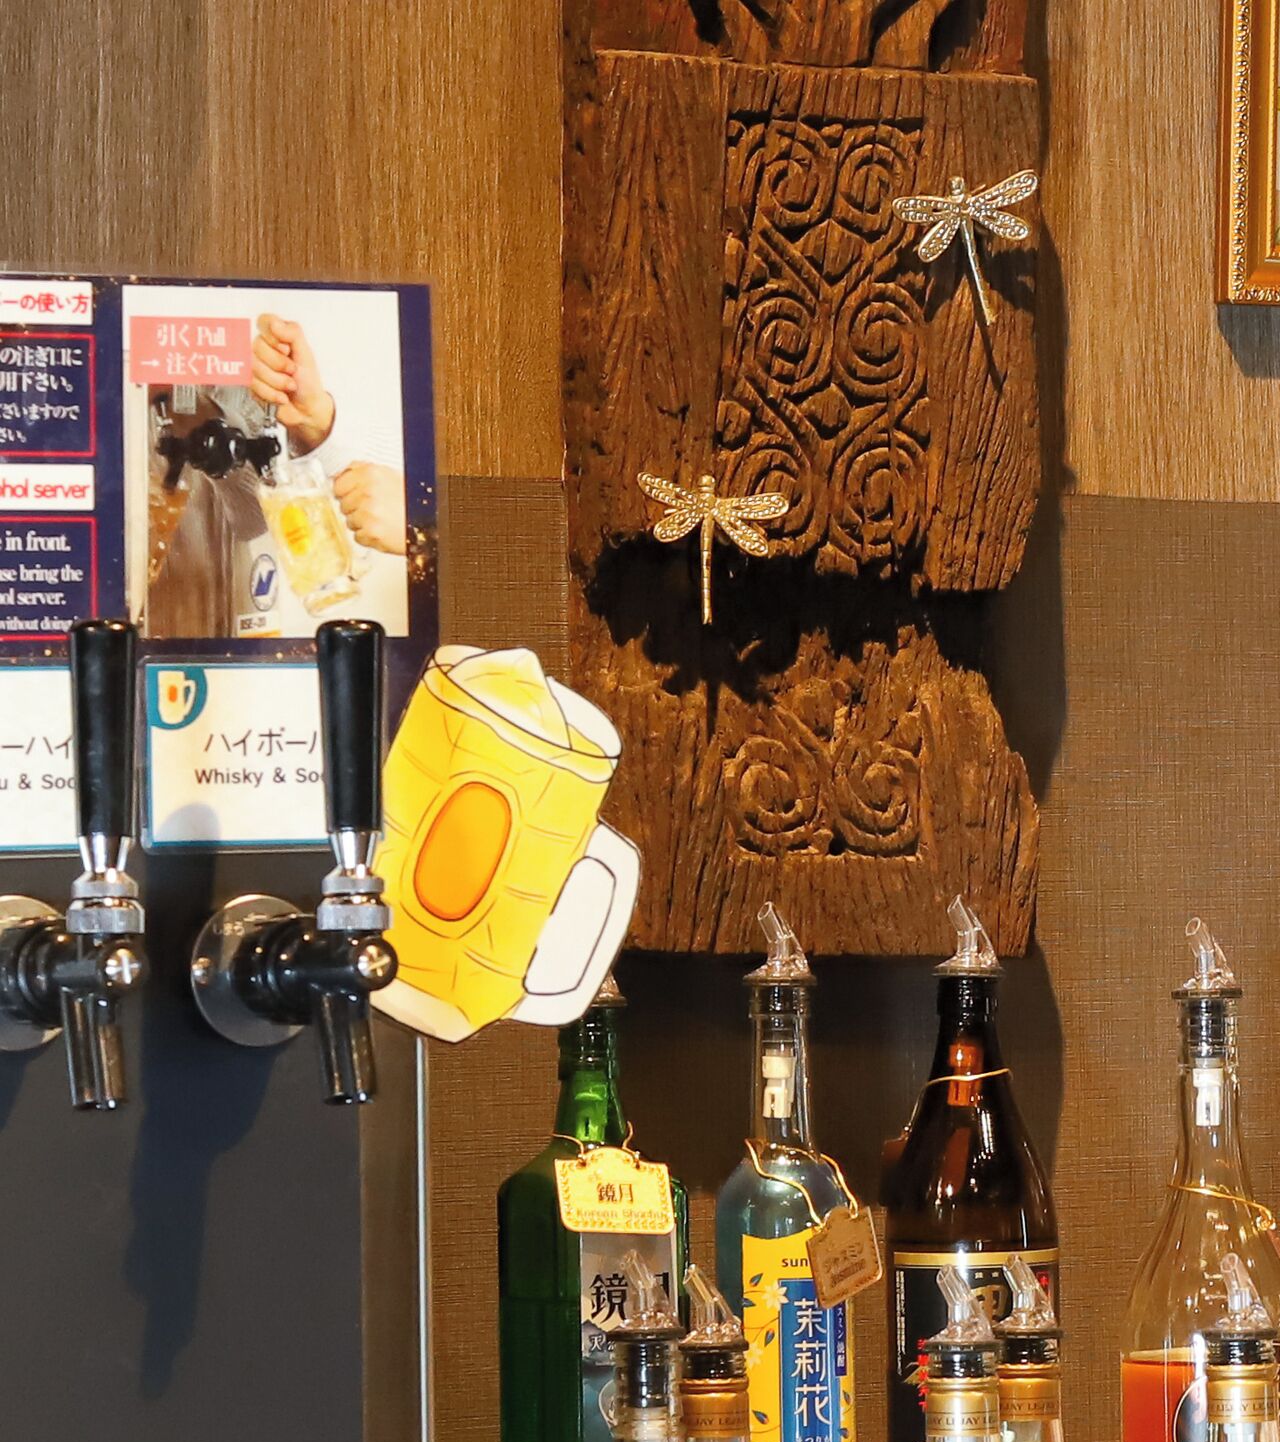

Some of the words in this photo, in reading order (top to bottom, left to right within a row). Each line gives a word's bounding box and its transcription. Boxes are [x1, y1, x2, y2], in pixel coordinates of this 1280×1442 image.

[34, 483, 90, 498] server
[6, 530, 22, 551] in
[26, 531, 71, 551] front.
[20, 564, 59, 584] bring
[61, 564, 83, 582] the
[17, 591, 67, 605] server.
[19, 774, 32, 791] &
[195, 766, 263, 787] Whisky
[273, 768, 287, 785] &
[597, 1183, 634, 1203] 鏡月
[791, 1298, 832, 1427] 茉莉花
